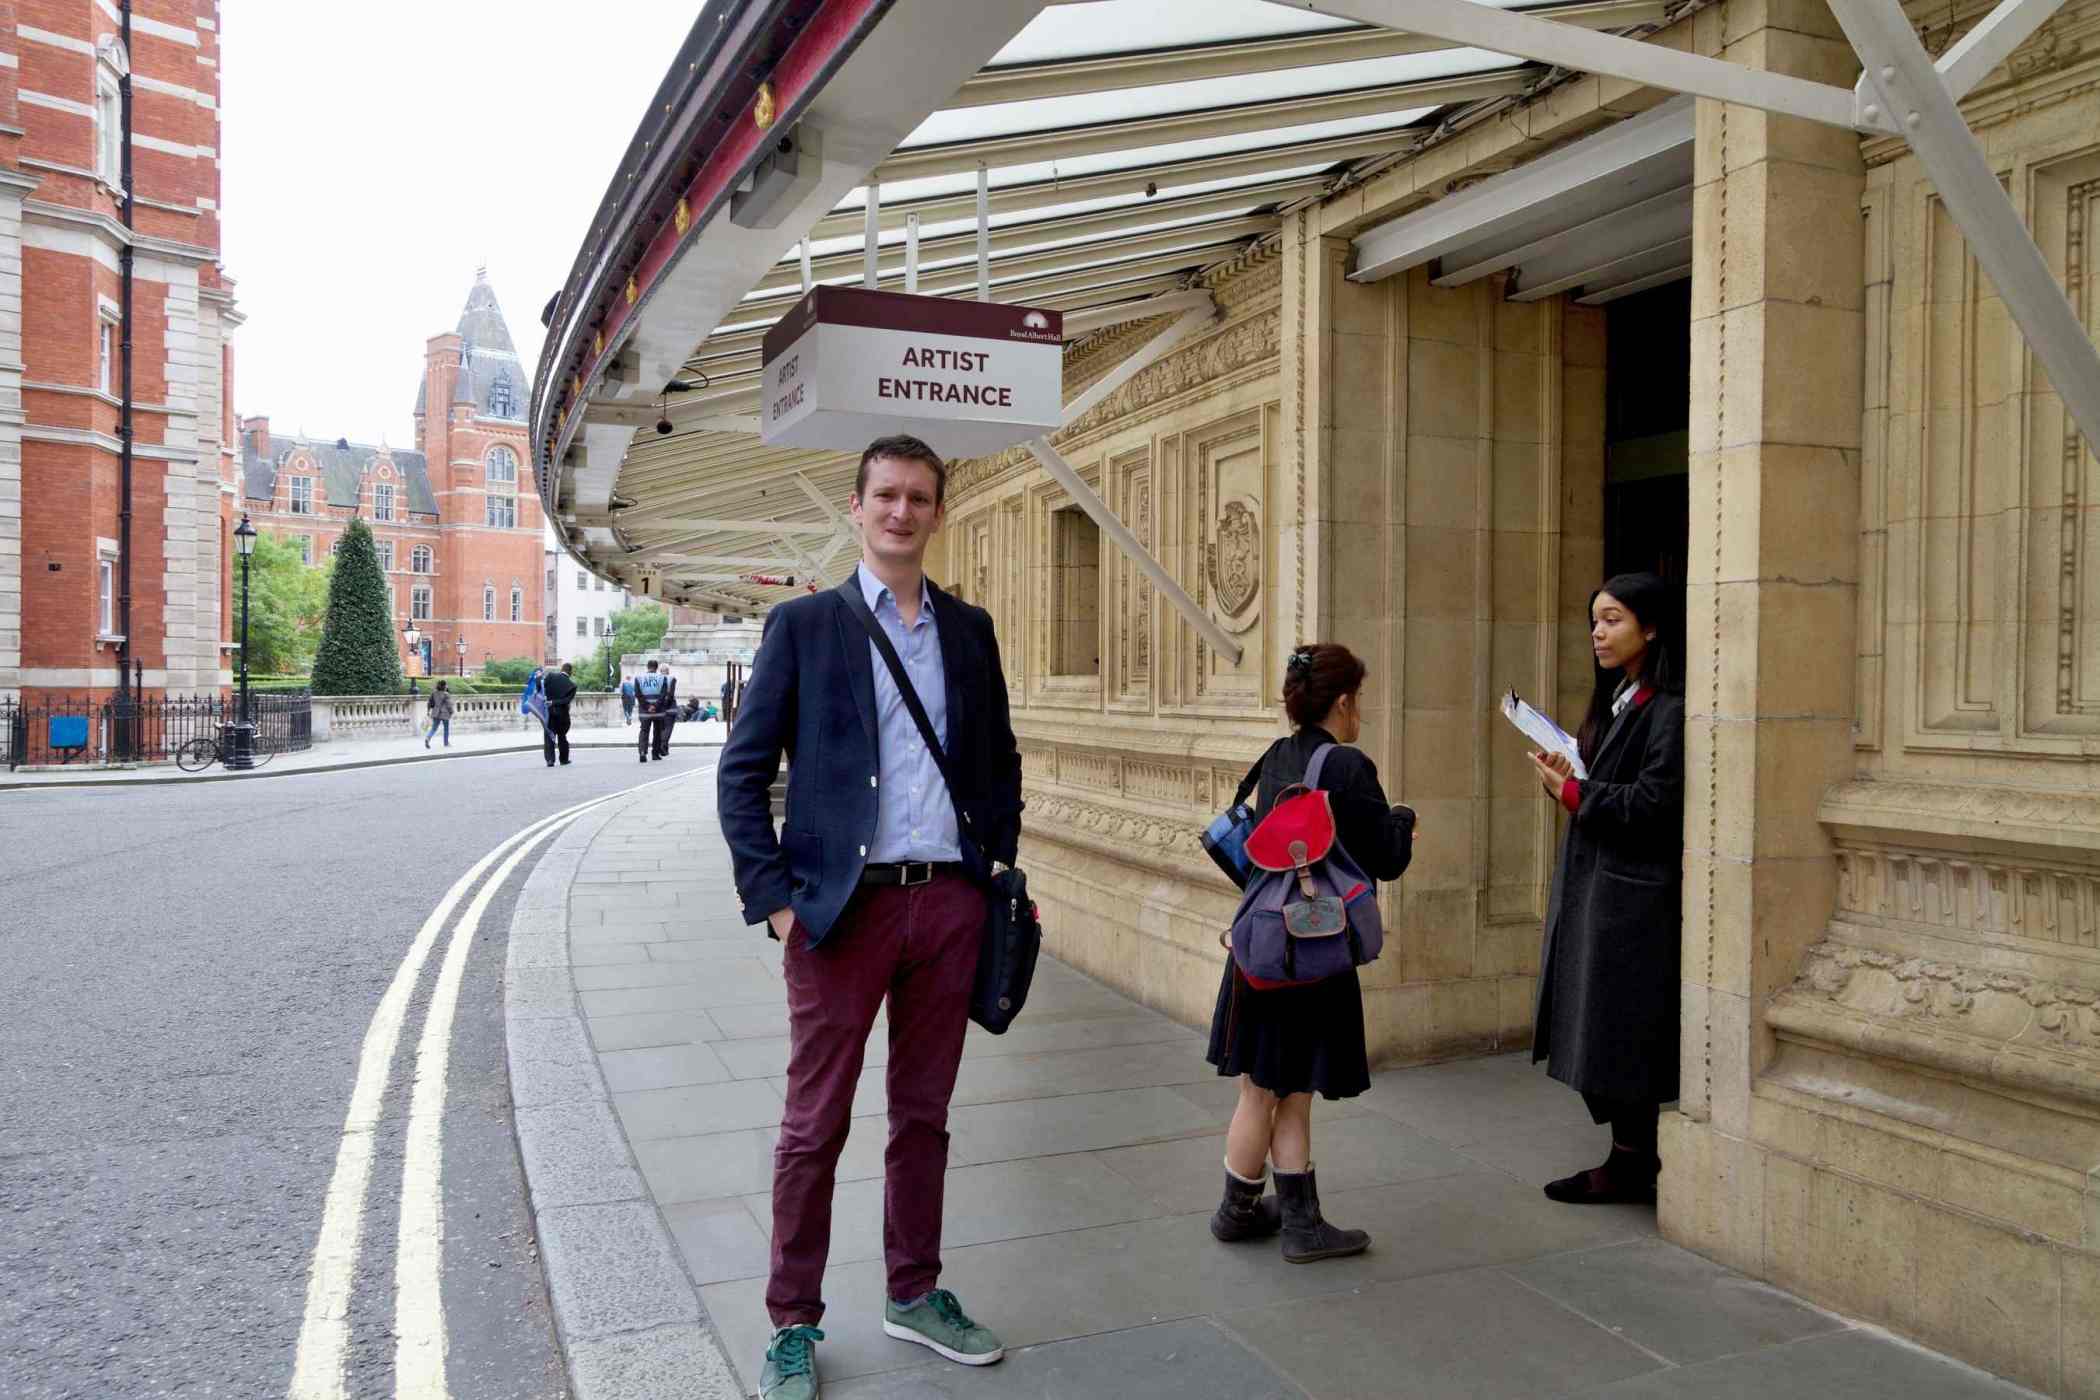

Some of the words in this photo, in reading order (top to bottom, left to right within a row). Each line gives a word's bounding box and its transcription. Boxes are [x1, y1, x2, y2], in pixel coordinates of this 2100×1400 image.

[778, 354, 799, 386] ARTIST
[902, 347, 990, 373] ARTIST
[772, 383, 804, 421] ENTRANCE
[878, 377, 1012, 407] ENTRANCE
[641, 577, 649, 594] 1
